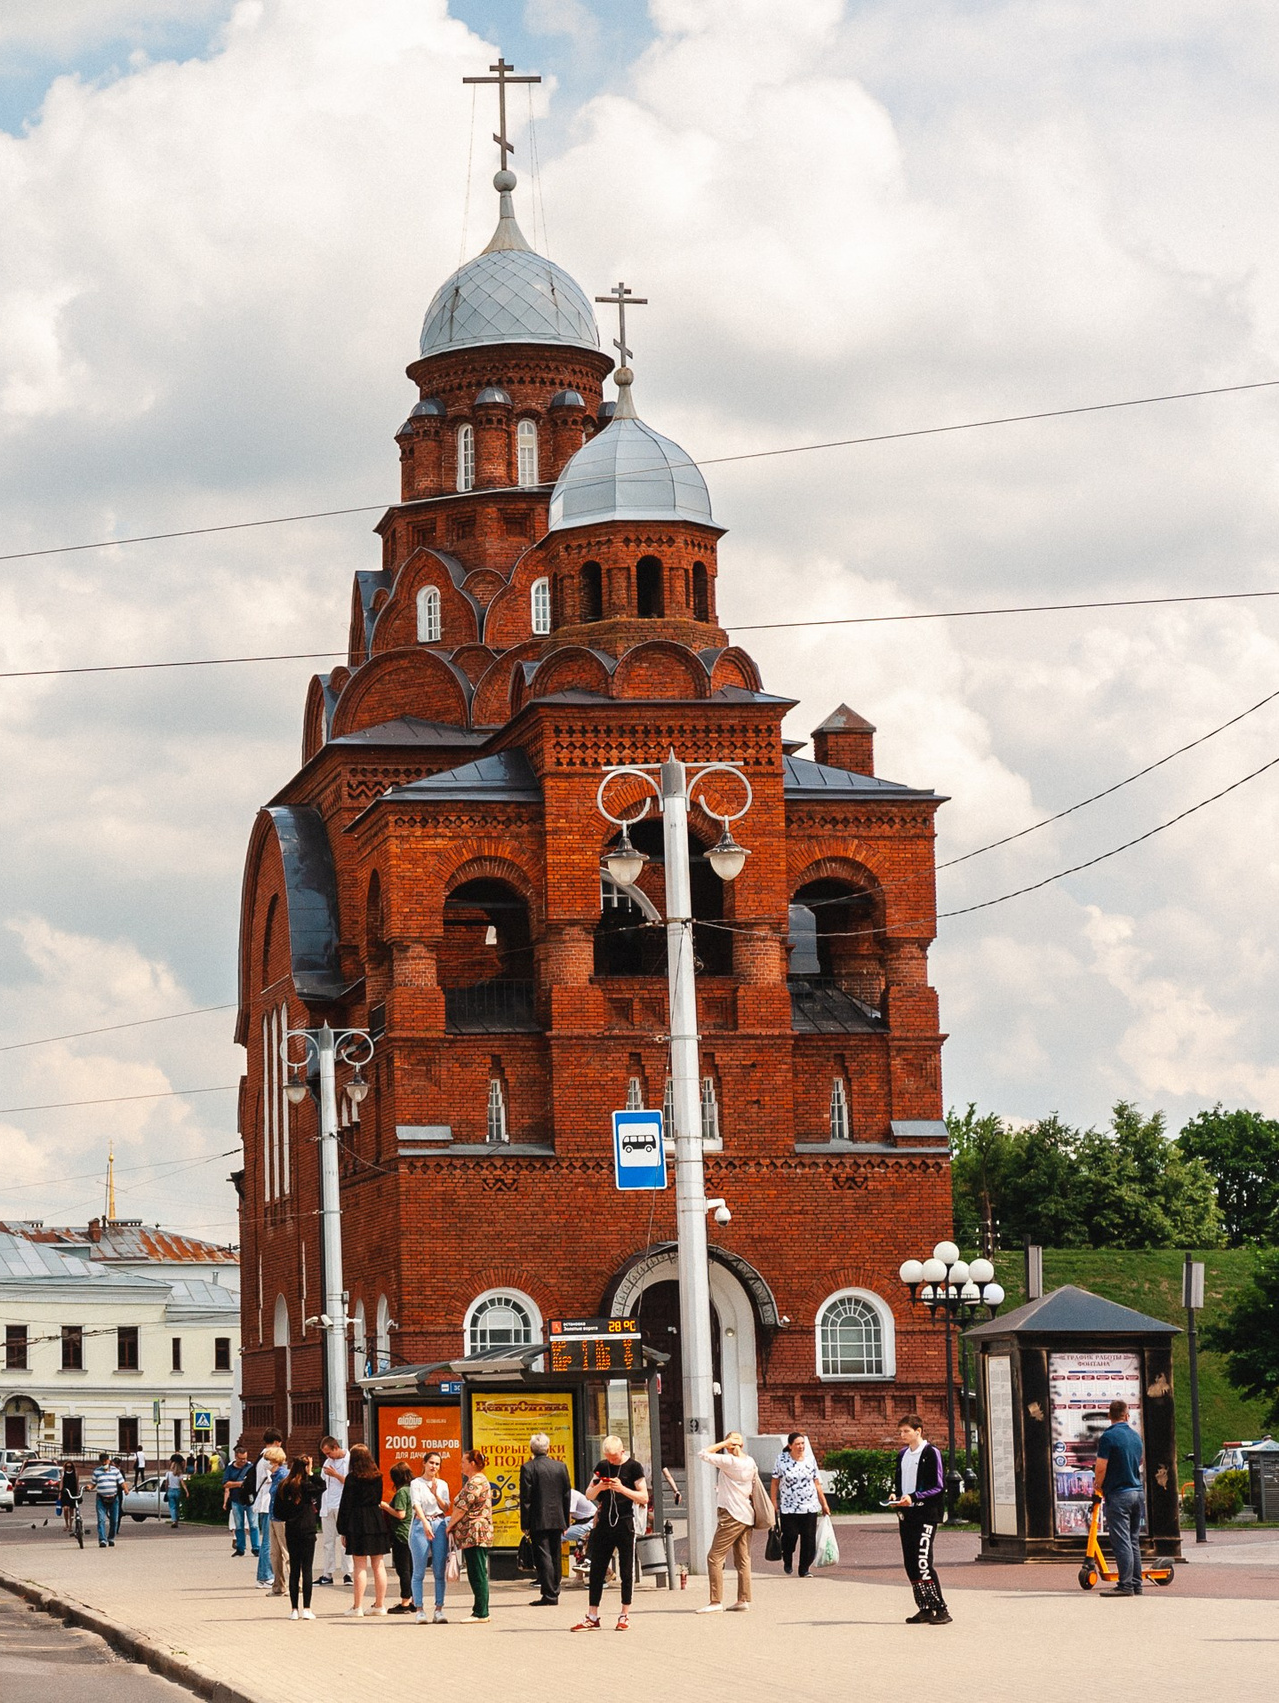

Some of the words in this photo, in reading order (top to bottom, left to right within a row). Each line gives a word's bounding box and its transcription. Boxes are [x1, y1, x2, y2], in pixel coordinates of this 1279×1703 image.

[608, 1321, 621, 1332] 28
[475, 1401, 569, 1414] ЦентрОптика
[690, 1419, 699, 1433] 9
[385, 1436, 417, 1449] 2000
[421, 1439, 460, 1449] ТОВАРОВ
[481, 1445, 529, 1454] ВТОРЫЕ
[918, 1524, 933, 1580] FICTION
